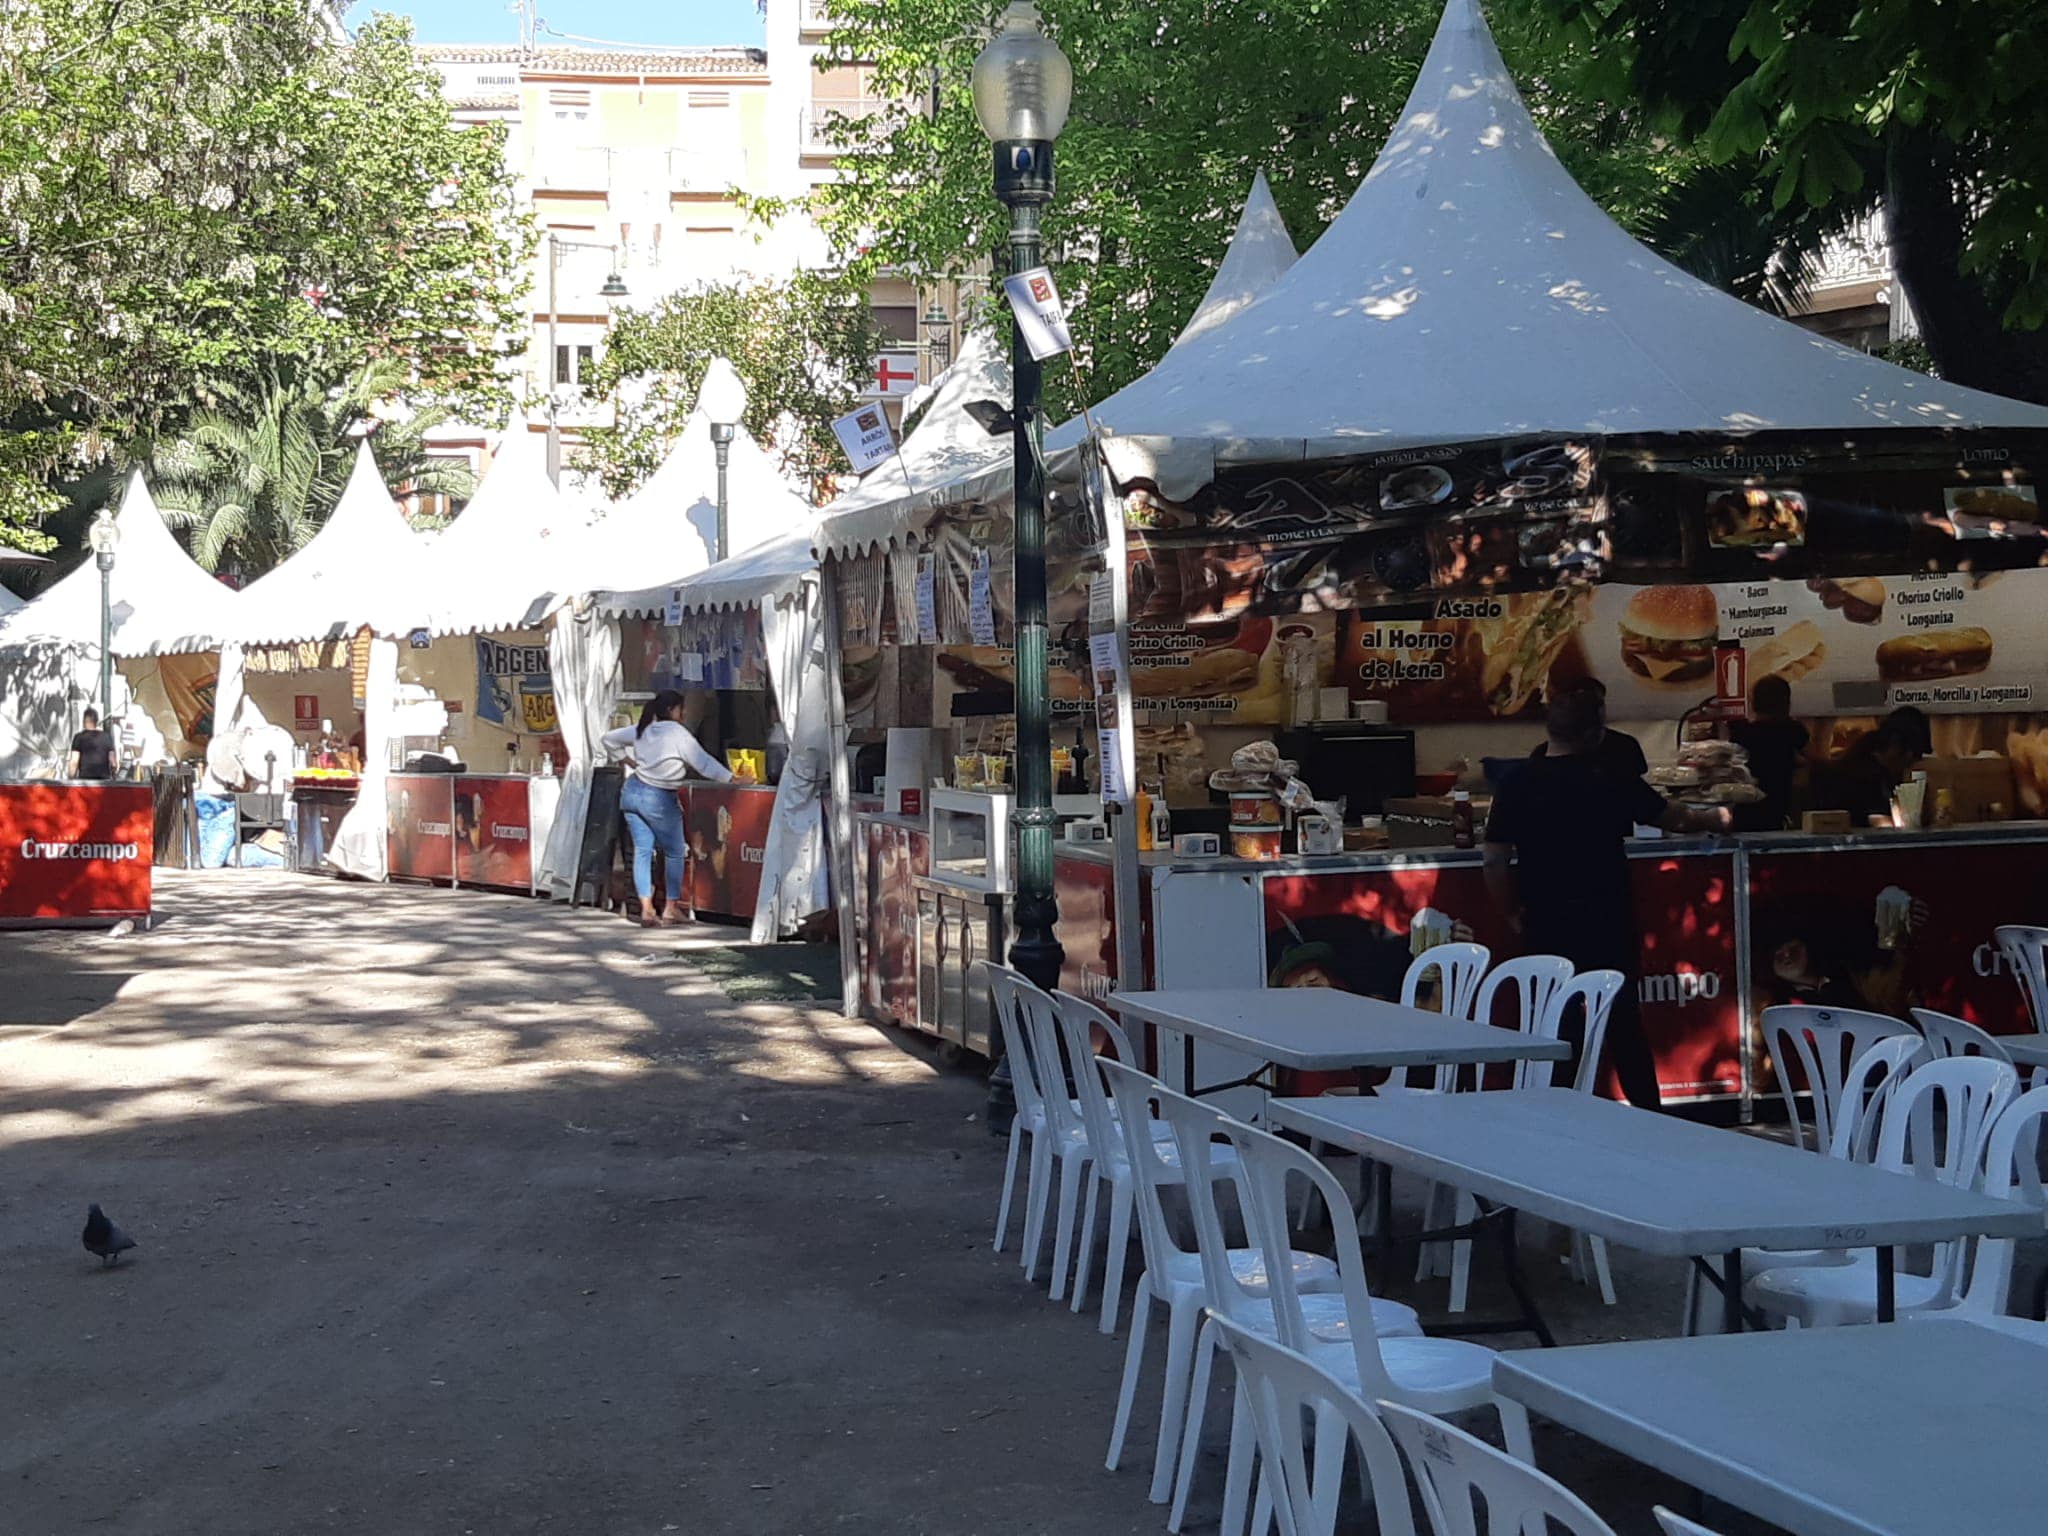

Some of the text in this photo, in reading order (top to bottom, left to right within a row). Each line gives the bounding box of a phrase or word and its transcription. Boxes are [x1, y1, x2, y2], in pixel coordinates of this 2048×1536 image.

[1896, 586, 1964, 605] Chorizo Criollo
[1437, 599, 1502, 618] Asado
[1907, 611, 1954, 628] Longaniza
[1129, 635, 1204, 648] orizo Criollo
[1362, 629, 1453, 648] al Horno
[1360, 659, 1391, 679] de
[1933, 687, 1971, 702] Morcilla
[1973, 690, 1979, 702] y
[1981, 684, 2033, 705] Longaniza)
[1159, 700, 1167, 712] y
[1170, 697, 1238, 712] Longaniza)
[21, 838, 138, 862] Cruzcampo
